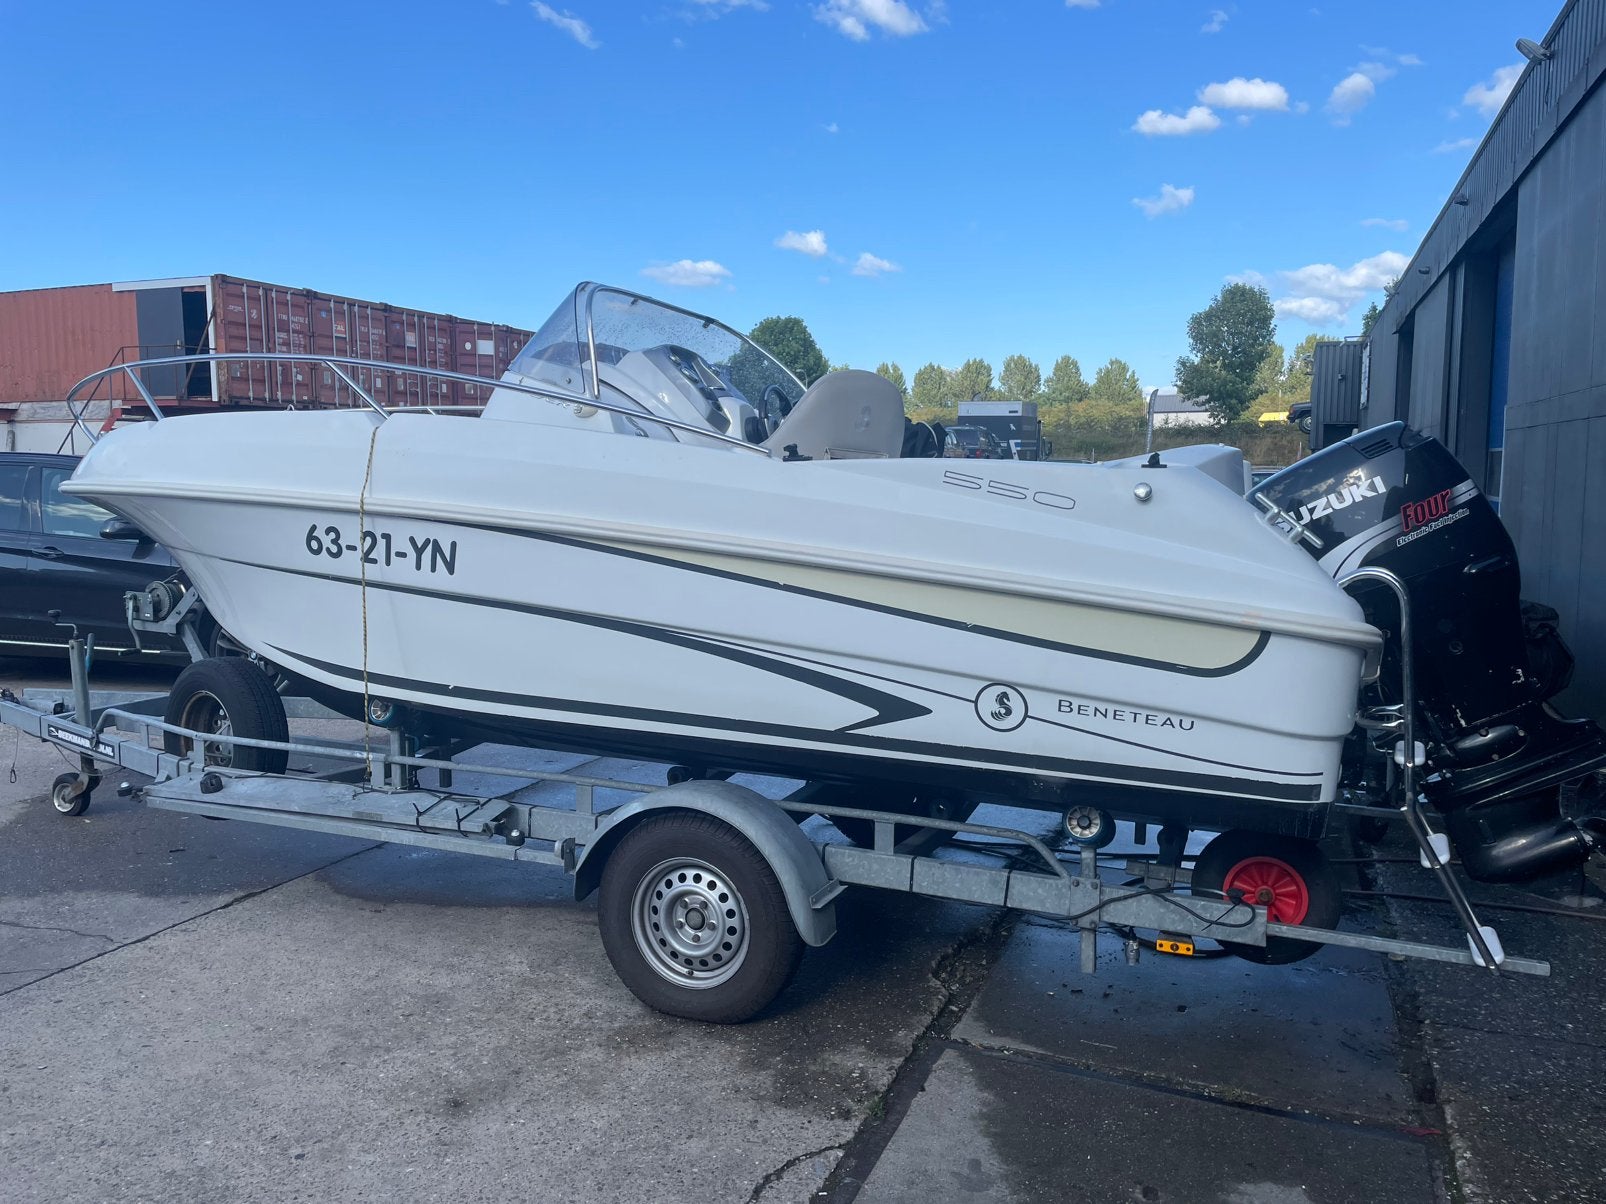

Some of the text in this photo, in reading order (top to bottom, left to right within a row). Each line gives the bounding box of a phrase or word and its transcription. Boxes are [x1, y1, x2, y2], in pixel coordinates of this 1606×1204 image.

[942, 470, 1077, 510] 550
[1400, 488, 1451, 532] Four
[305, 523, 457, 576] 63-21-YN
[1396, 526, 1430, 547] Electronic
